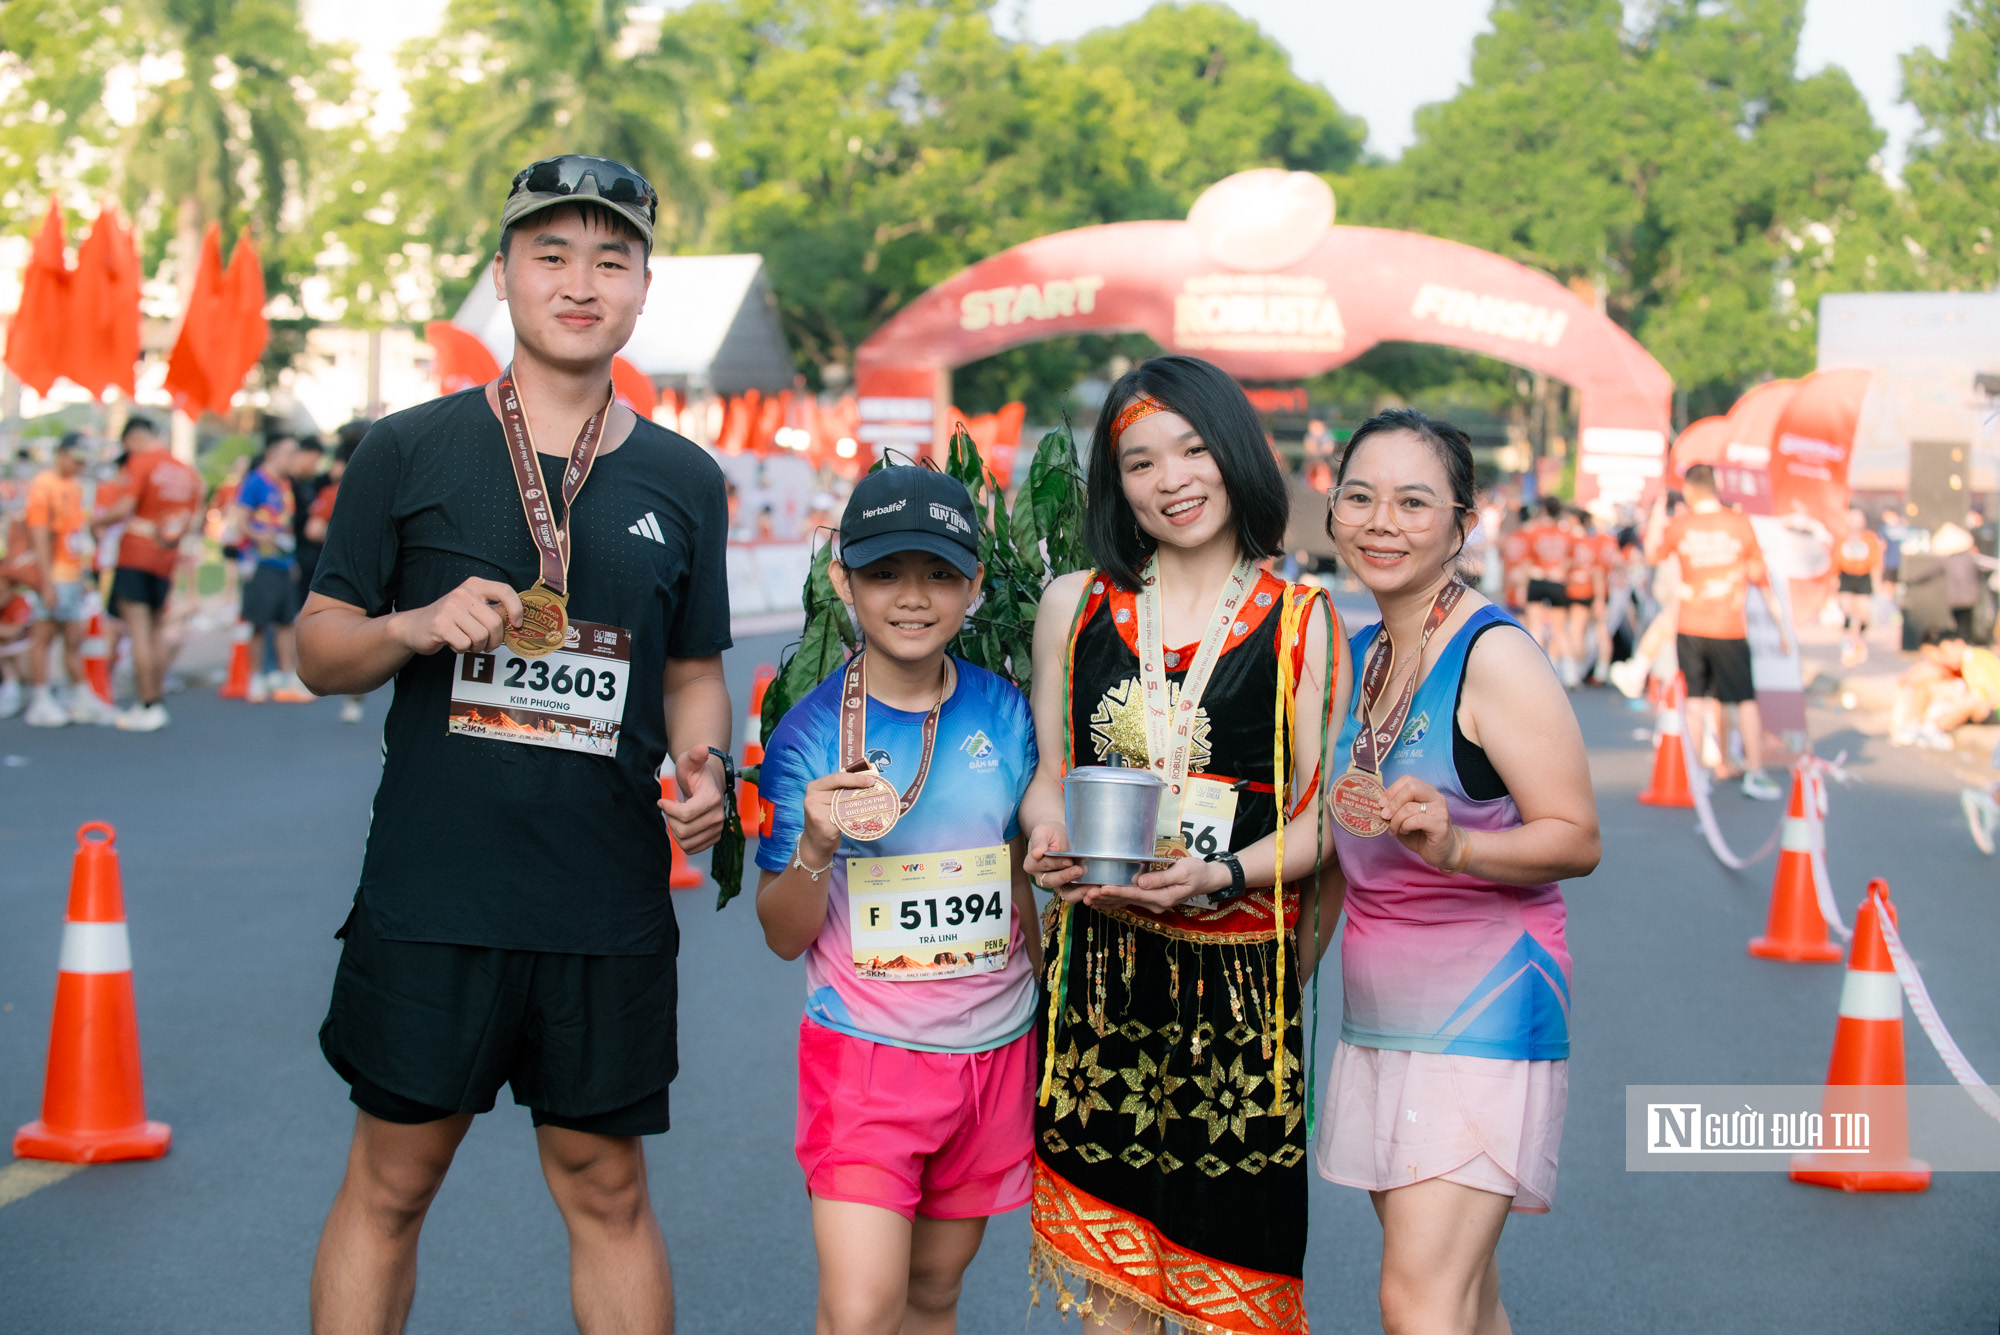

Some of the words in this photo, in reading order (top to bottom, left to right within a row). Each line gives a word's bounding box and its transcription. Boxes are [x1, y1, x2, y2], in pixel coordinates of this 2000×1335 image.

[961, 277, 1099, 330] START
[1413, 284, 1567, 346] FINISH
[862, 502, 902, 520] Herbalife
[930, 506, 949, 522] QUY
[523, 607, 558, 630] OBUSTA
[472, 658, 485, 678] F
[504, 657, 616, 701] 23603
[510, 696, 528, 706] KIM
[530, 698, 570, 712] PHƯỢNG
[461, 724, 486, 734] 21KM
[589, 720, 606, 732] PEN
[607, 722, 613, 733] C
[1172, 745, 1184, 780] ROBUSTA
[870, 907, 880, 926] F
[900, 891, 1002, 930] 51394
[919, 933, 936, 944] TRÀ
[939, 934, 958, 942] LINH
[984, 940, 997, 950] PEN
